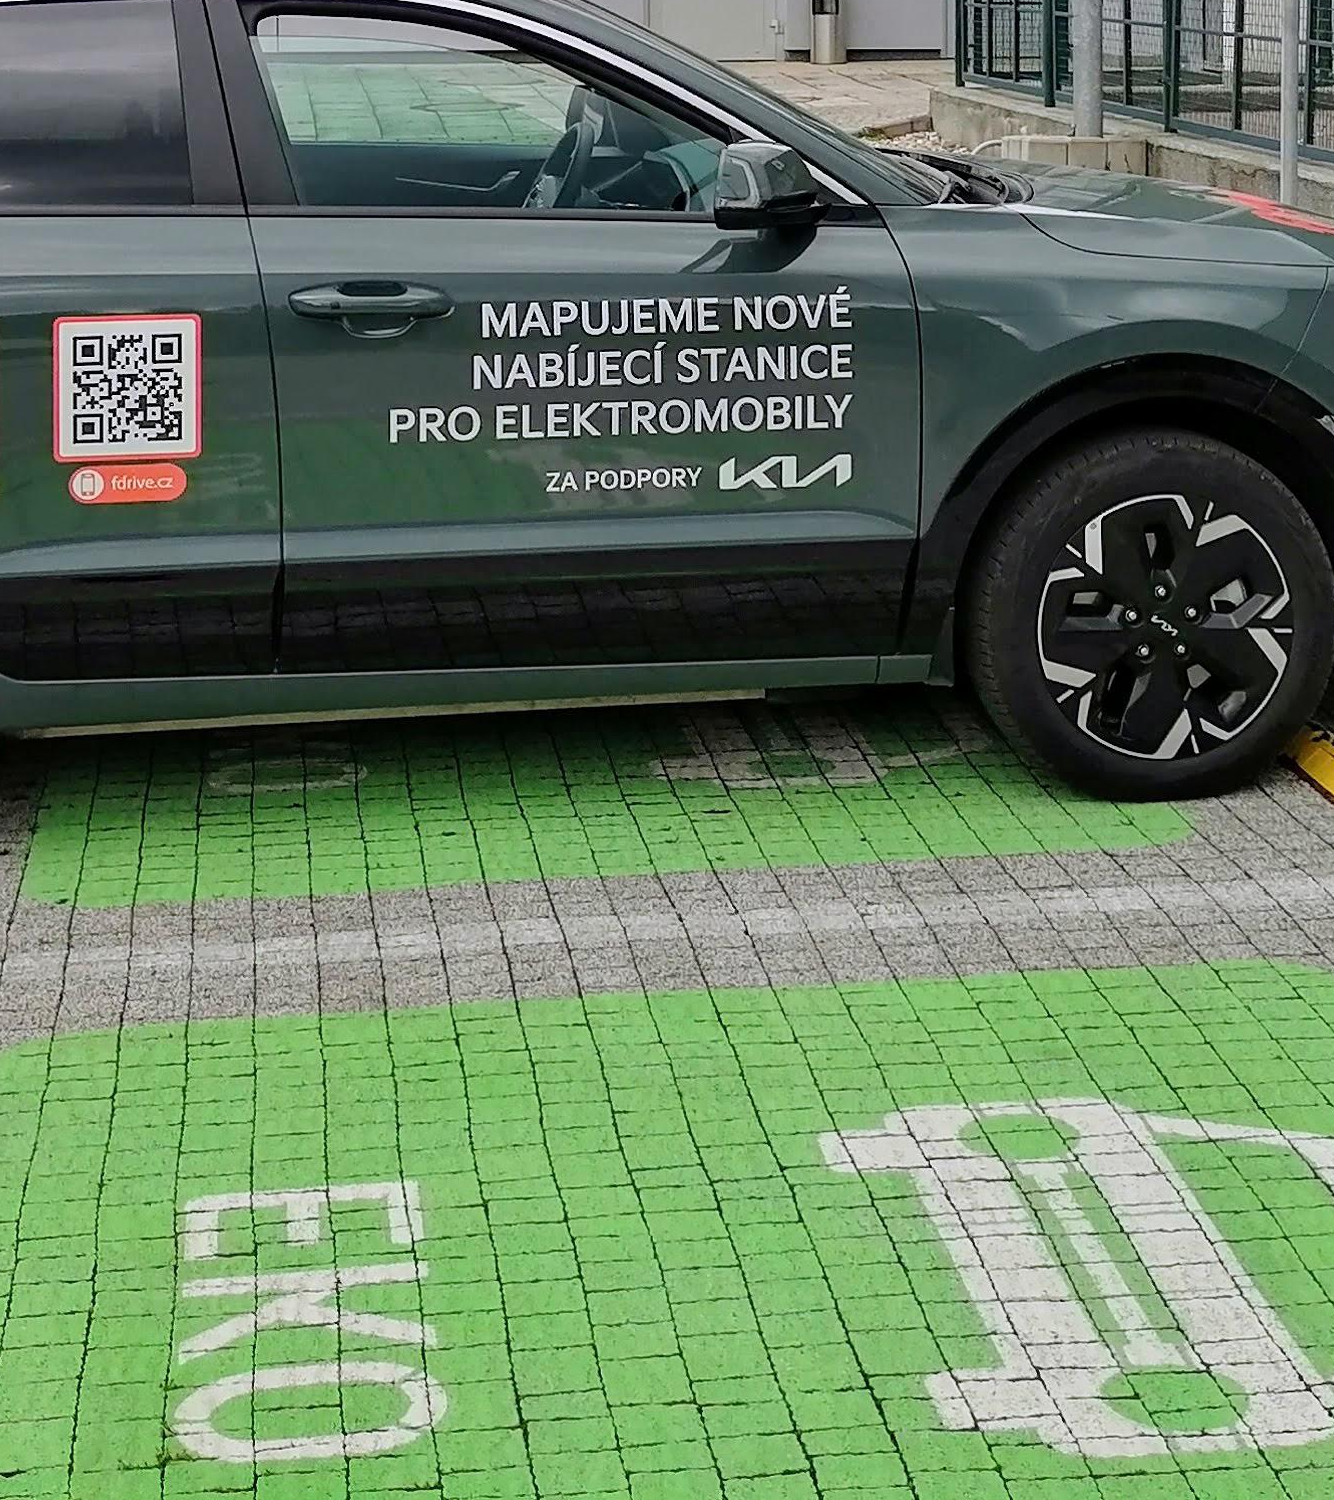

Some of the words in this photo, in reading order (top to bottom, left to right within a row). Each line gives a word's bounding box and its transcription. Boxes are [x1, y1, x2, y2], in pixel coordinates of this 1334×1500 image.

[480, 296, 720, 339] MAPUJEME
[733, 286, 853, 332] NOVÉ
[472, 342, 667, 390] NABÍJECÍ
[676, 343, 854, 383] STANICE
[388, 406, 482, 443] PRO
[495, 394, 854, 440] ELEKTROMOBILY
[110, 474, 175, 492] fdrive.cz
[545, 471, 578, 493] ZA
[584, 467, 702, 491] PODPORY
[718, 453, 853, 491] KIA
[173, 1180, 448, 1462] EKO
